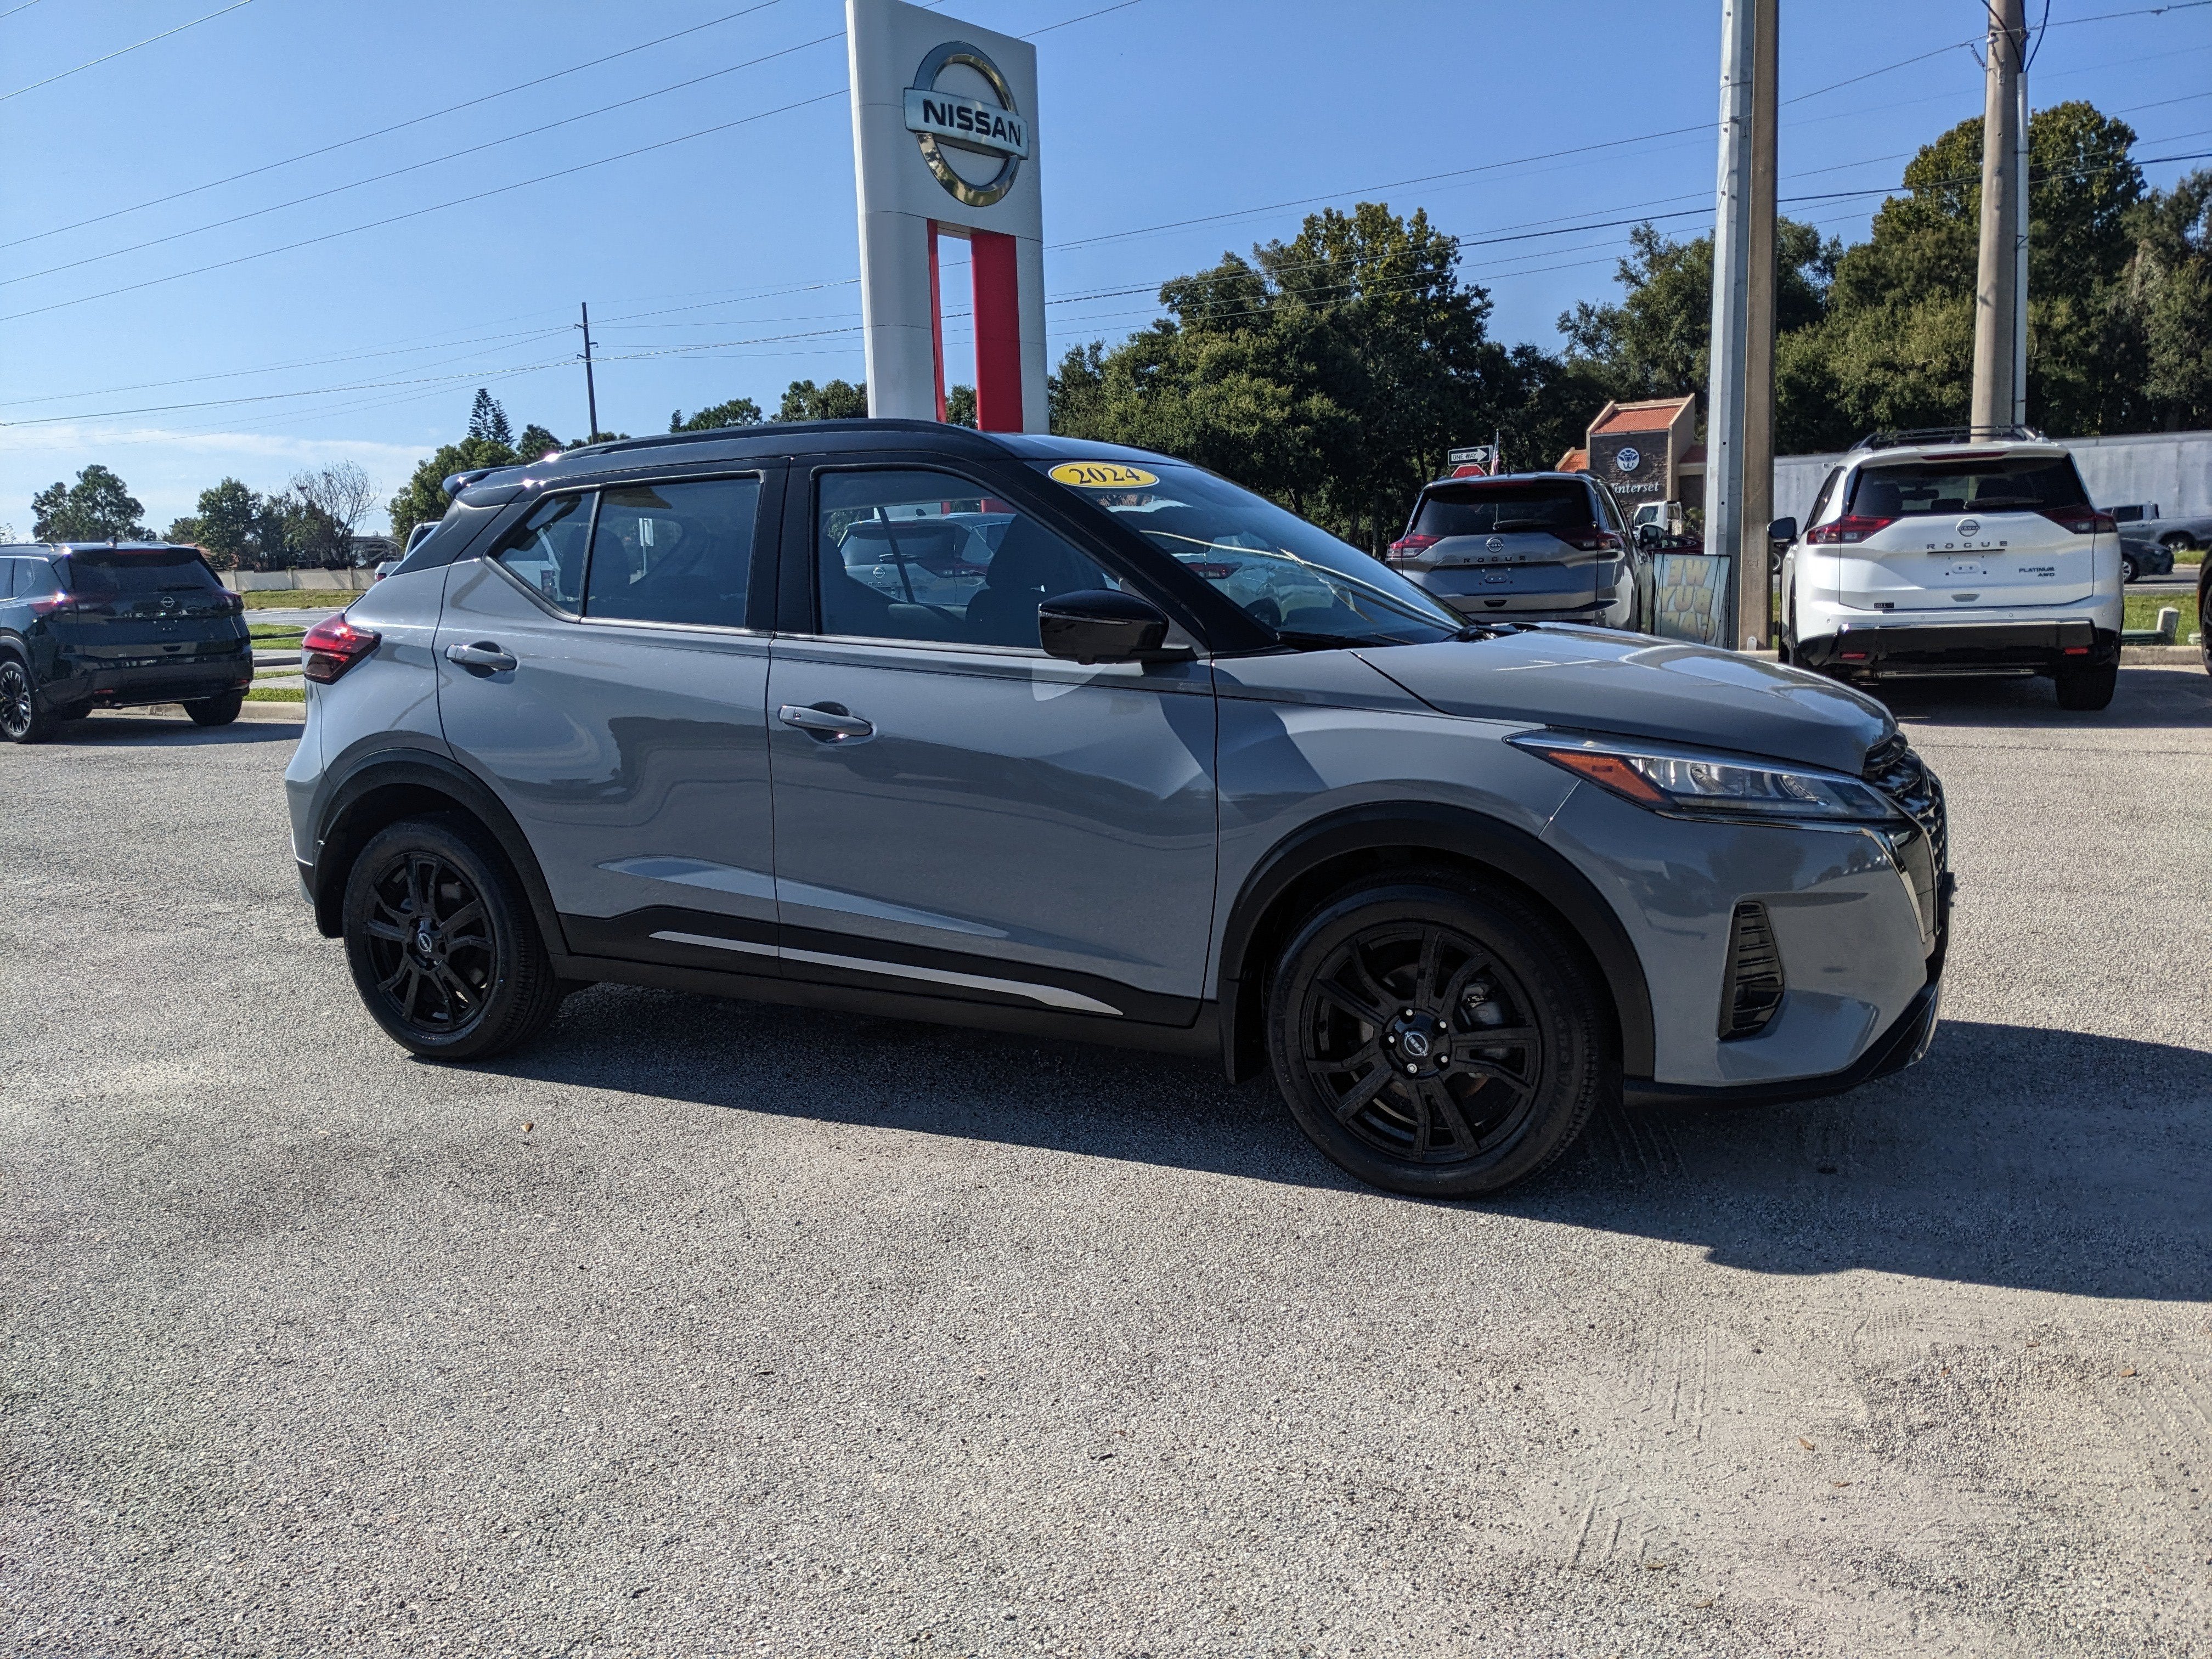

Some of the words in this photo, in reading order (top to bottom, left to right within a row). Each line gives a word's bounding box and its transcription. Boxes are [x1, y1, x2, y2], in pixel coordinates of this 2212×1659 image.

[923, 99, 1022, 148] NISSAN
[1069, 467, 1141, 484] 2024
[1610, 481, 1660, 494] interset
[1927, 540, 2007, 550] ROGUE
[1404, 1031, 1427, 1057] NISSAN
